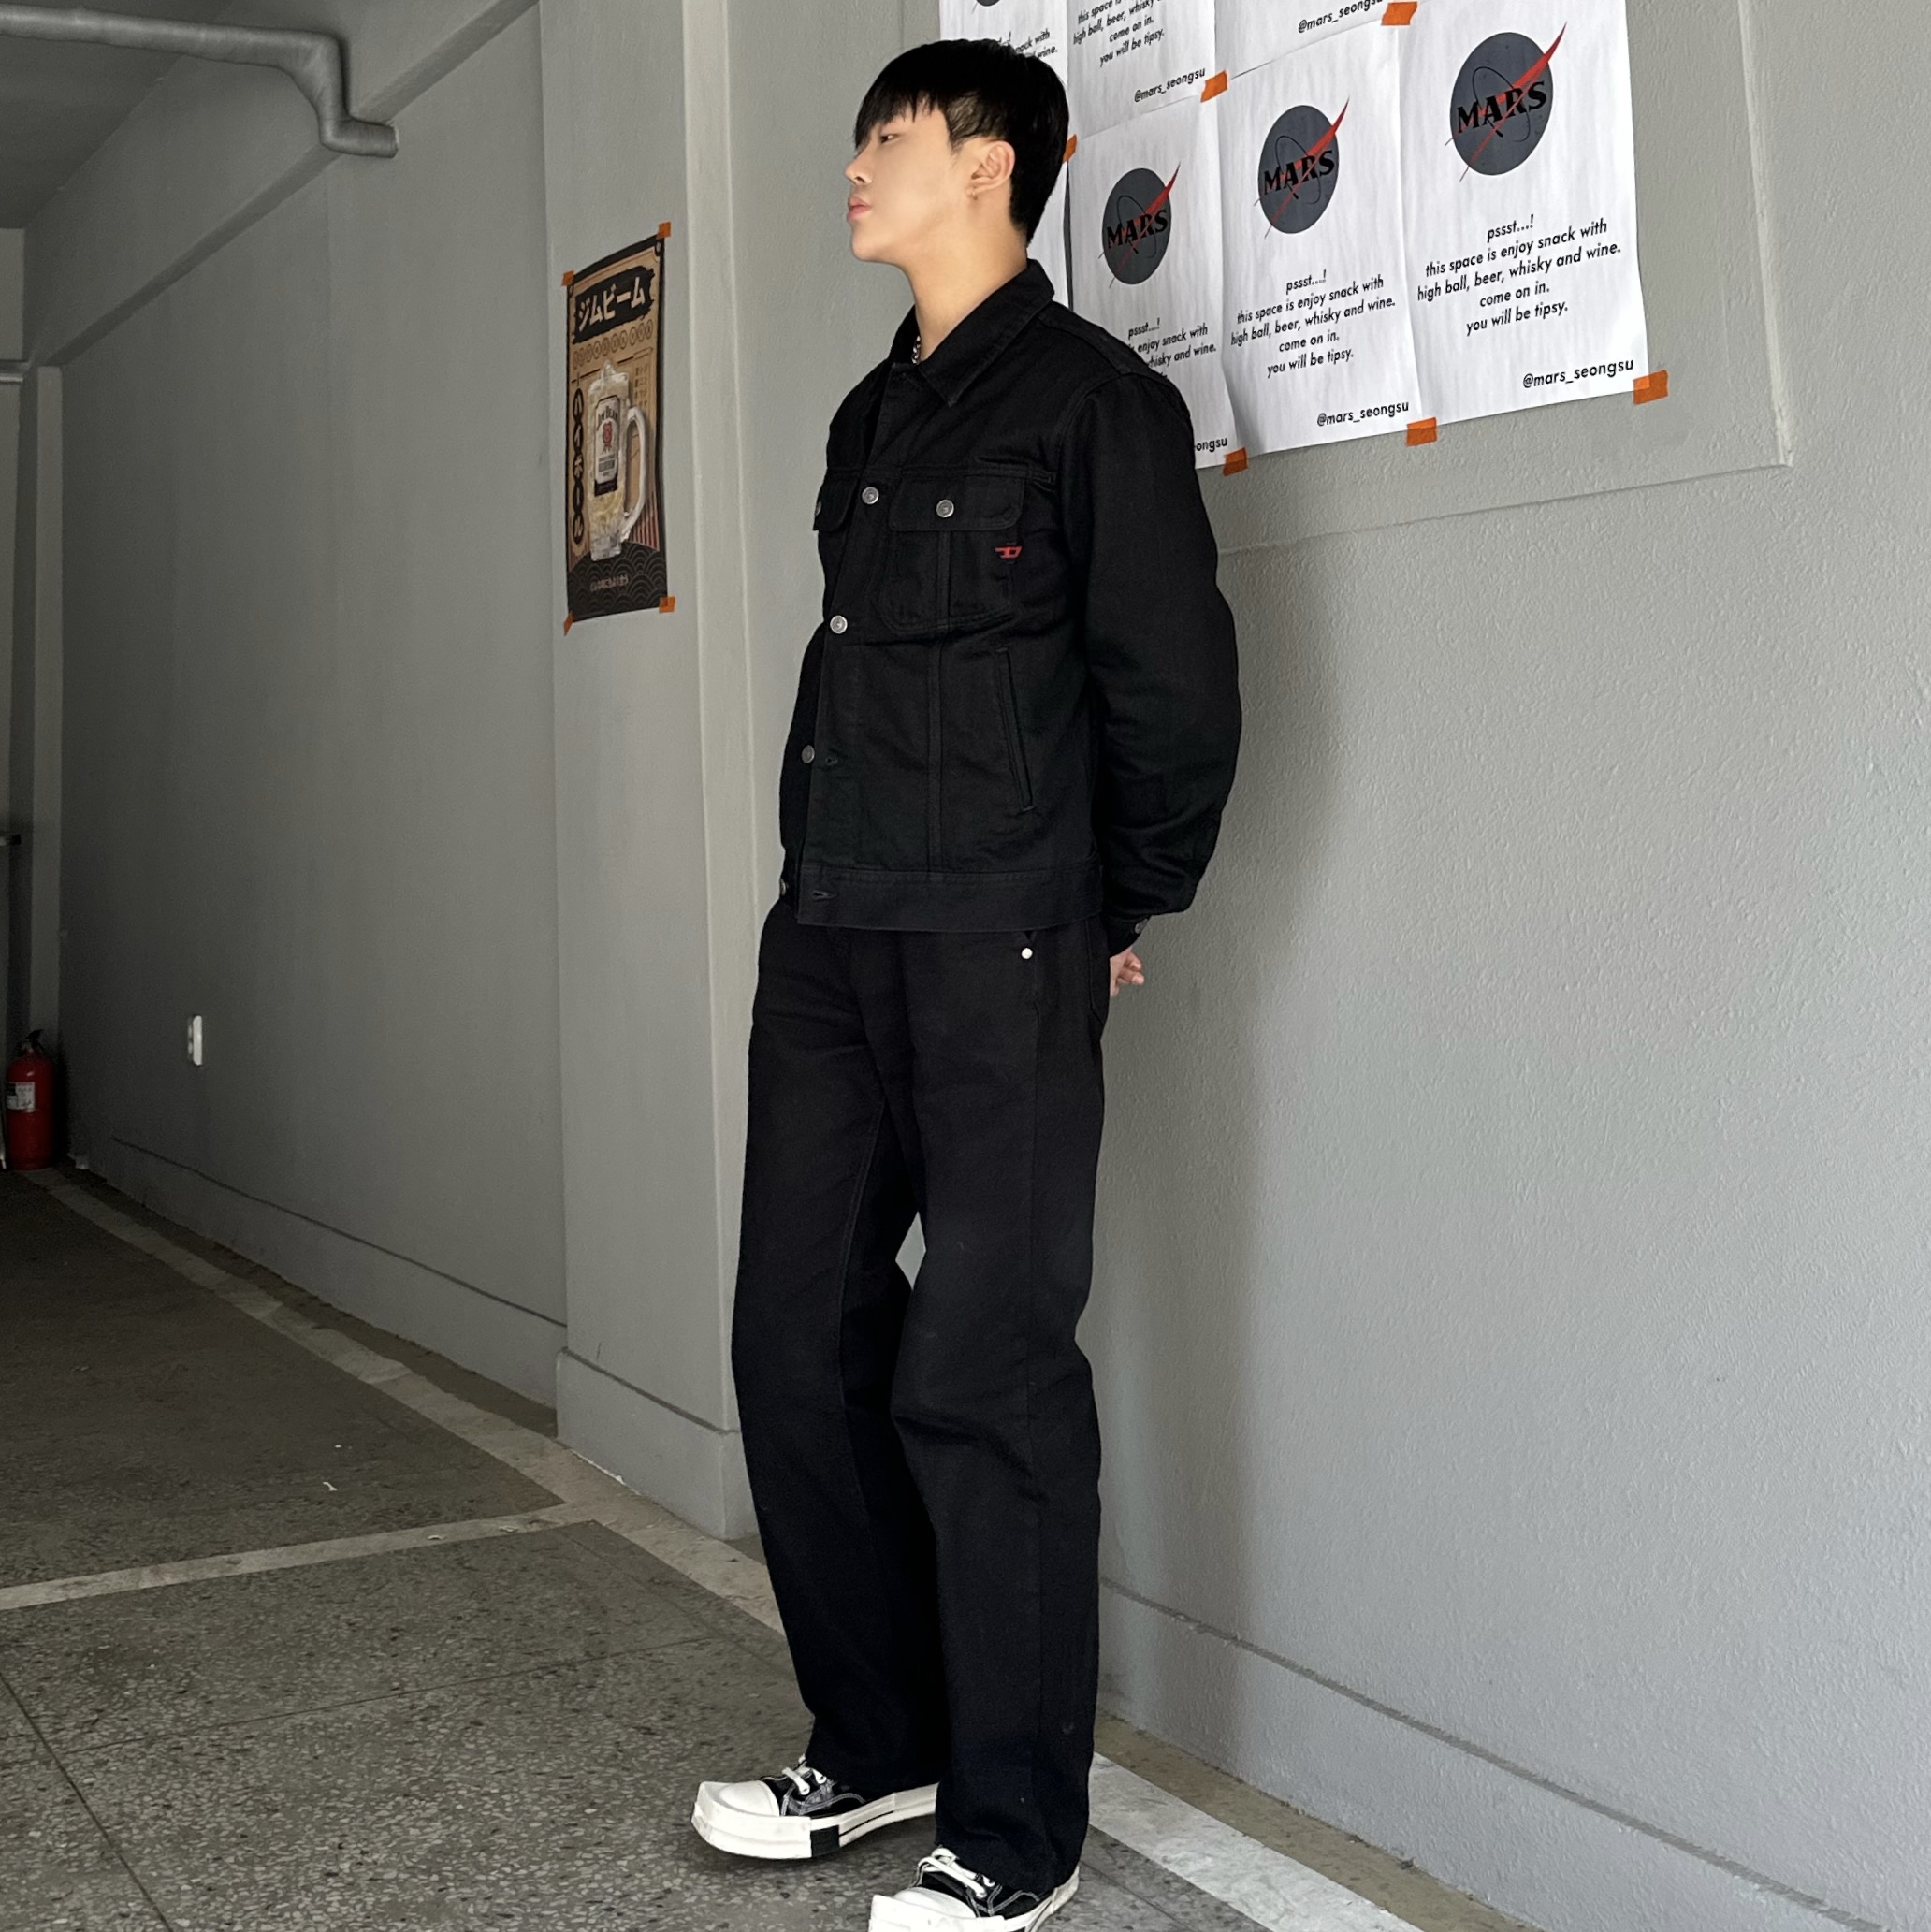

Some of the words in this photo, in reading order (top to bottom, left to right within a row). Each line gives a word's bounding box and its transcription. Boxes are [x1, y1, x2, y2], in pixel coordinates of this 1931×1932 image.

[1073, 27, 1086, 45] high
[1088, 18, 1104, 36] ball,
[1107, 11, 1126, 26] beer,
[1078, 10, 1089, 24] this
[1091, 0, 1112, 18] space
[1109, 26, 1130, 42] come
[1132, 21, 1141, 32] on
[1144, 14, 1154, 26] in.
[1014, 36, 1033, 53] nack
[1035, 28, 1050, 43] with
[1099, 51, 1113, 68] you
[1116, 39, 1129, 56] will
[1131, 37, 1141, 50] be
[1144, 29, 1164, 46] tipsy.
[1134, 67, 1206, 103] @mars_seongsu
[1457, 80, 1547, 134] MARS
[1263, 150, 1335, 196] MARS
[1106, 208, 1169, 250] MARS
[1487, 213, 1534, 243] pssst...!
[1425, 261, 1446, 278] this
[1448, 254, 1484, 274] space
[1487, 247, 1497, 262] is
[1500, 240, 1534, 259] enjoy
[1537, 225, 1576, 249] snack
[1579, 217, 1607, 239] with
[1285, 269, 1327, 295] pssst...!
[1417, 281, 1442, 302] high
[1445, 274, 1470, 295] ball,
[1474, 271, 1505, 288] beer,
[1509, 256, 1552, 279] whisky
[1556, 246, 1582, 268] and
[1586, 241, 1621, 261] wine.
[578, 276, 646, 332] ジムビーム
[1237, 308, 1253, 324] this
[1255, 303, 1283, 322] space
[1285, 298, 1295, 312] is
[1297, 292, 1327, 310] enjoy
[1328, 280, 1359, 301] snack
[1362, 273, 1385, 292] with
[1479, 290, 1512, 308] come
[1515, 286, 1531, 299] on
[1534, 280, 1550, 295] in.
[1128, 317, 1160, 341] pssst...!
[1230, 328, 1248, 347] high
[1251, 322, 1271, 340] ball,
[1274, 320, 1301, 334] beer,
[1304, 307, 1342, 327] whisky
[1343, 299, 1365, 318] and
[1367, 295, 1396, 312] wine.
[1466, 318, 1488, 337] you
[1491, 308, 1512, 327] will
[1515, 306, 1531, 322] be
[1534, 300, 1569, 319] tipsy.
[1138, 338, 1160, 355] enjoy
[1162, 327, 1187, 346] snack
[1189, 322, 1208, 338] with
[1148, 352, 1172, 368] hisky
[1173, 344, 1192, 362] and
[1193, 341, 1217, 356] wine.
[1279, 336, 1307, 353] come
[1310, 332, 1324, 347] on
[1327, 328, 1340, 343] in.
[1267, 361, 1285, 379] you
[1288, 354, 1307, 370] will
[1310, 351, 1324, 367] be
[1327, 348, 1354, 366] tipsy.
[1523, 359, 1634, 389] @mars_seongsu
[1316, 401, 1410, 427] @mars_seongsu
